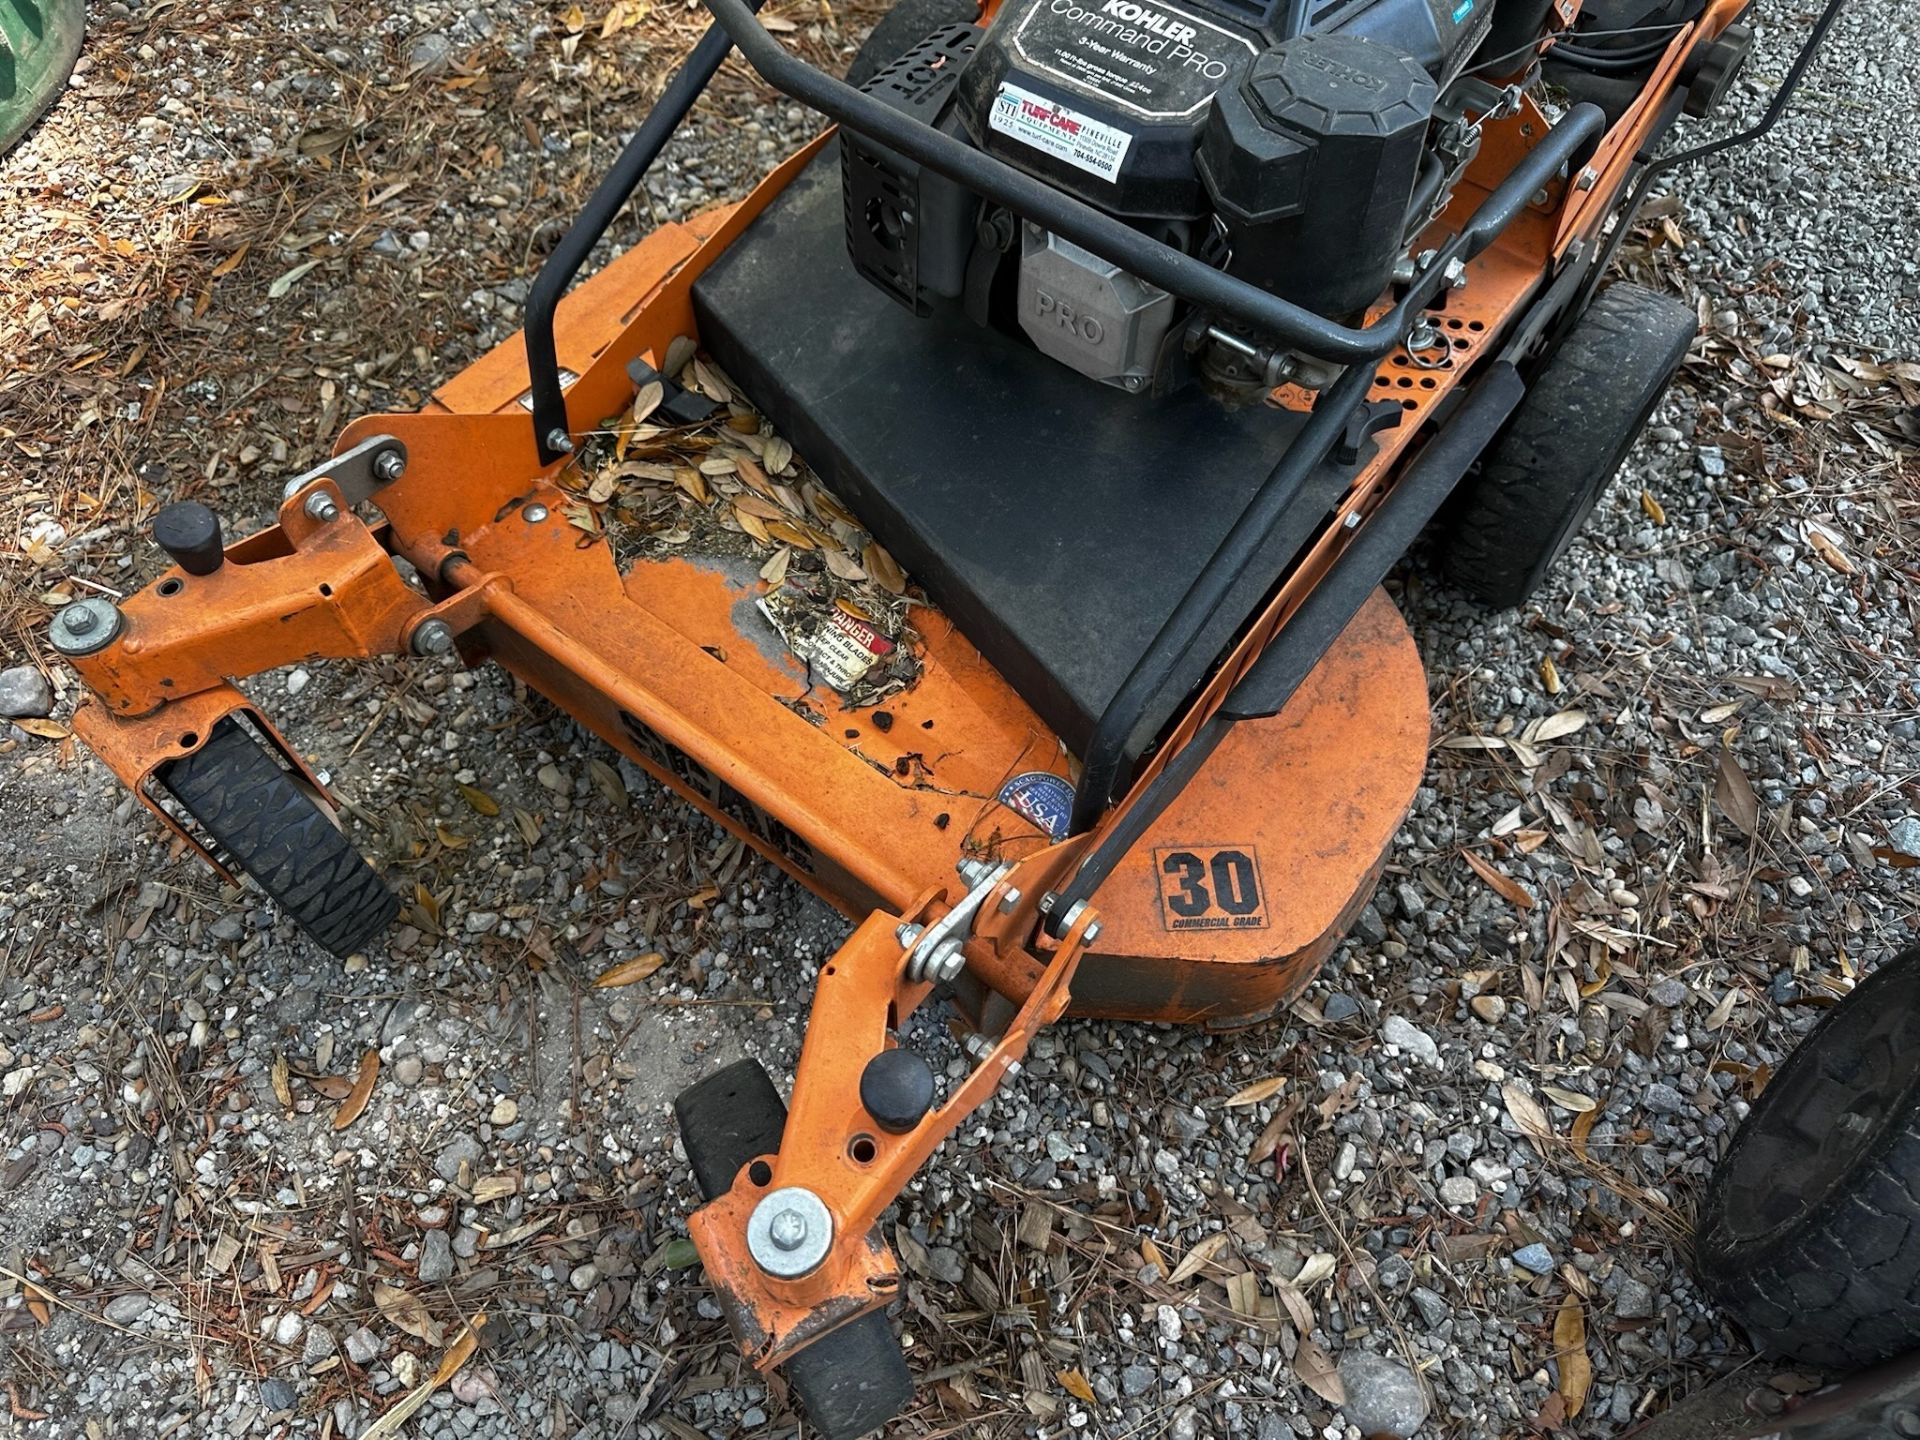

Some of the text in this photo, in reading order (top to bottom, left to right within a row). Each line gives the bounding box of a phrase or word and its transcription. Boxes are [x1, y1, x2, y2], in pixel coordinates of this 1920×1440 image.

[1050, 0, 1170, 55] Command
[1166, 45, 1227, 79] PRO
[1078, 36, 1158, 75] 3-Year Warranty
[1301, 50, 1388, 93] KOHLER
[998, 100, 1017, 117] STI
[993, 114, 1014, 129] 1925
[1018, 126, 1068, 152] www.turf-care.com
[1081, 125, 1122, 148] PINEVILLE
[1073, 148, 1112, 172] 704-554-0500
[1035, 288, 1105, 345] PRO
[829, 644, 849, 661] CLEAR
[843, 640, 873, 665] BLADES
[835, 661, 852, 679] THRO
[1014, 790, 1058, 833] USA
[1163, 851, 1260, 917] 30
[1172, 916, 1263, 929] COMMERCIAL GRADE
